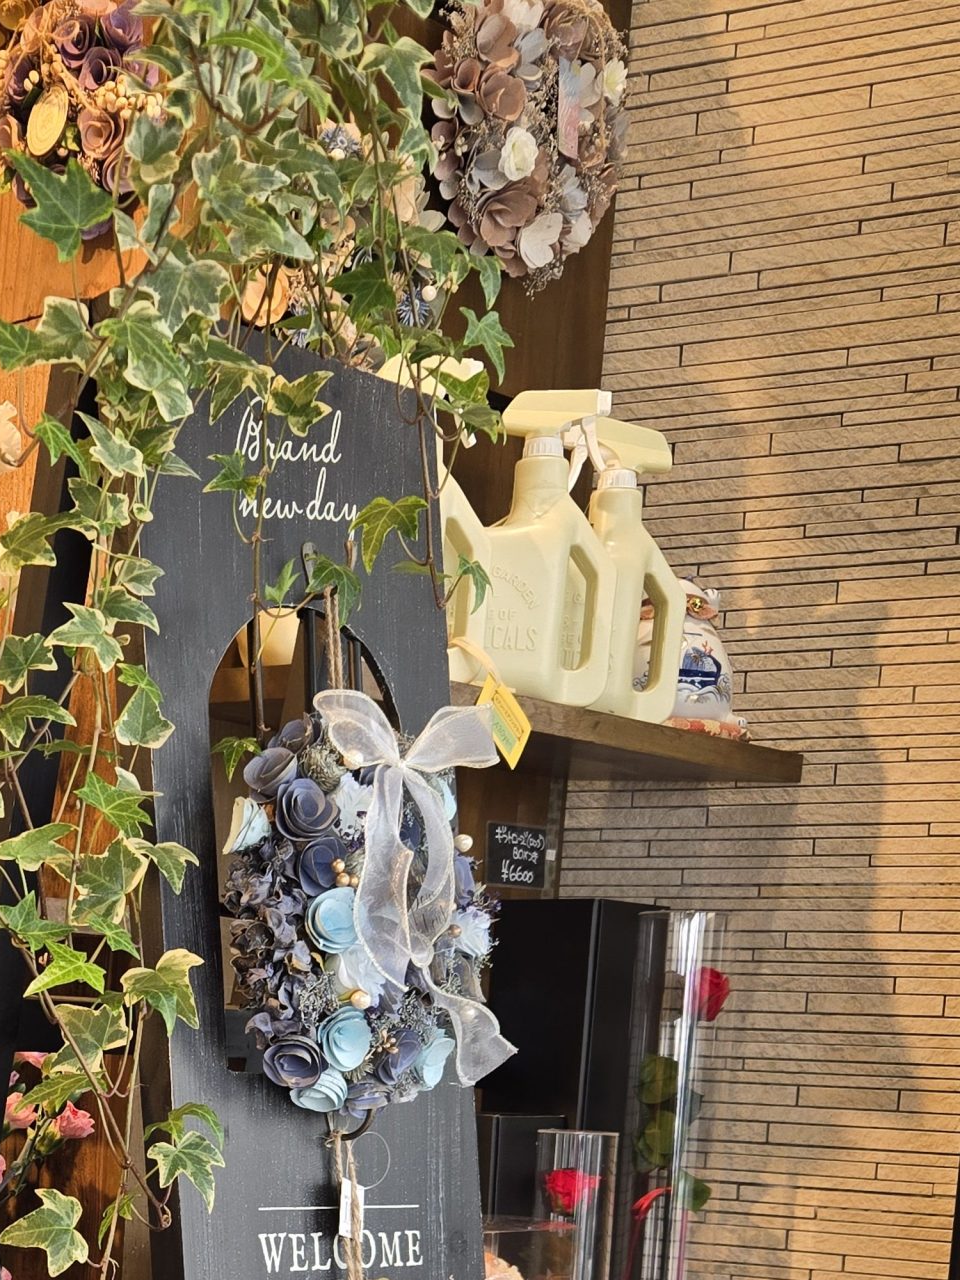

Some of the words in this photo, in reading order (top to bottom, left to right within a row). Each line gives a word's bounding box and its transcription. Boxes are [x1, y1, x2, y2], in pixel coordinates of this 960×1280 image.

[236, 395, 342, 464] Brand
[501, 859, 534, 884] ¥6600
[258, 1230, 424, 1273] WELCOME
